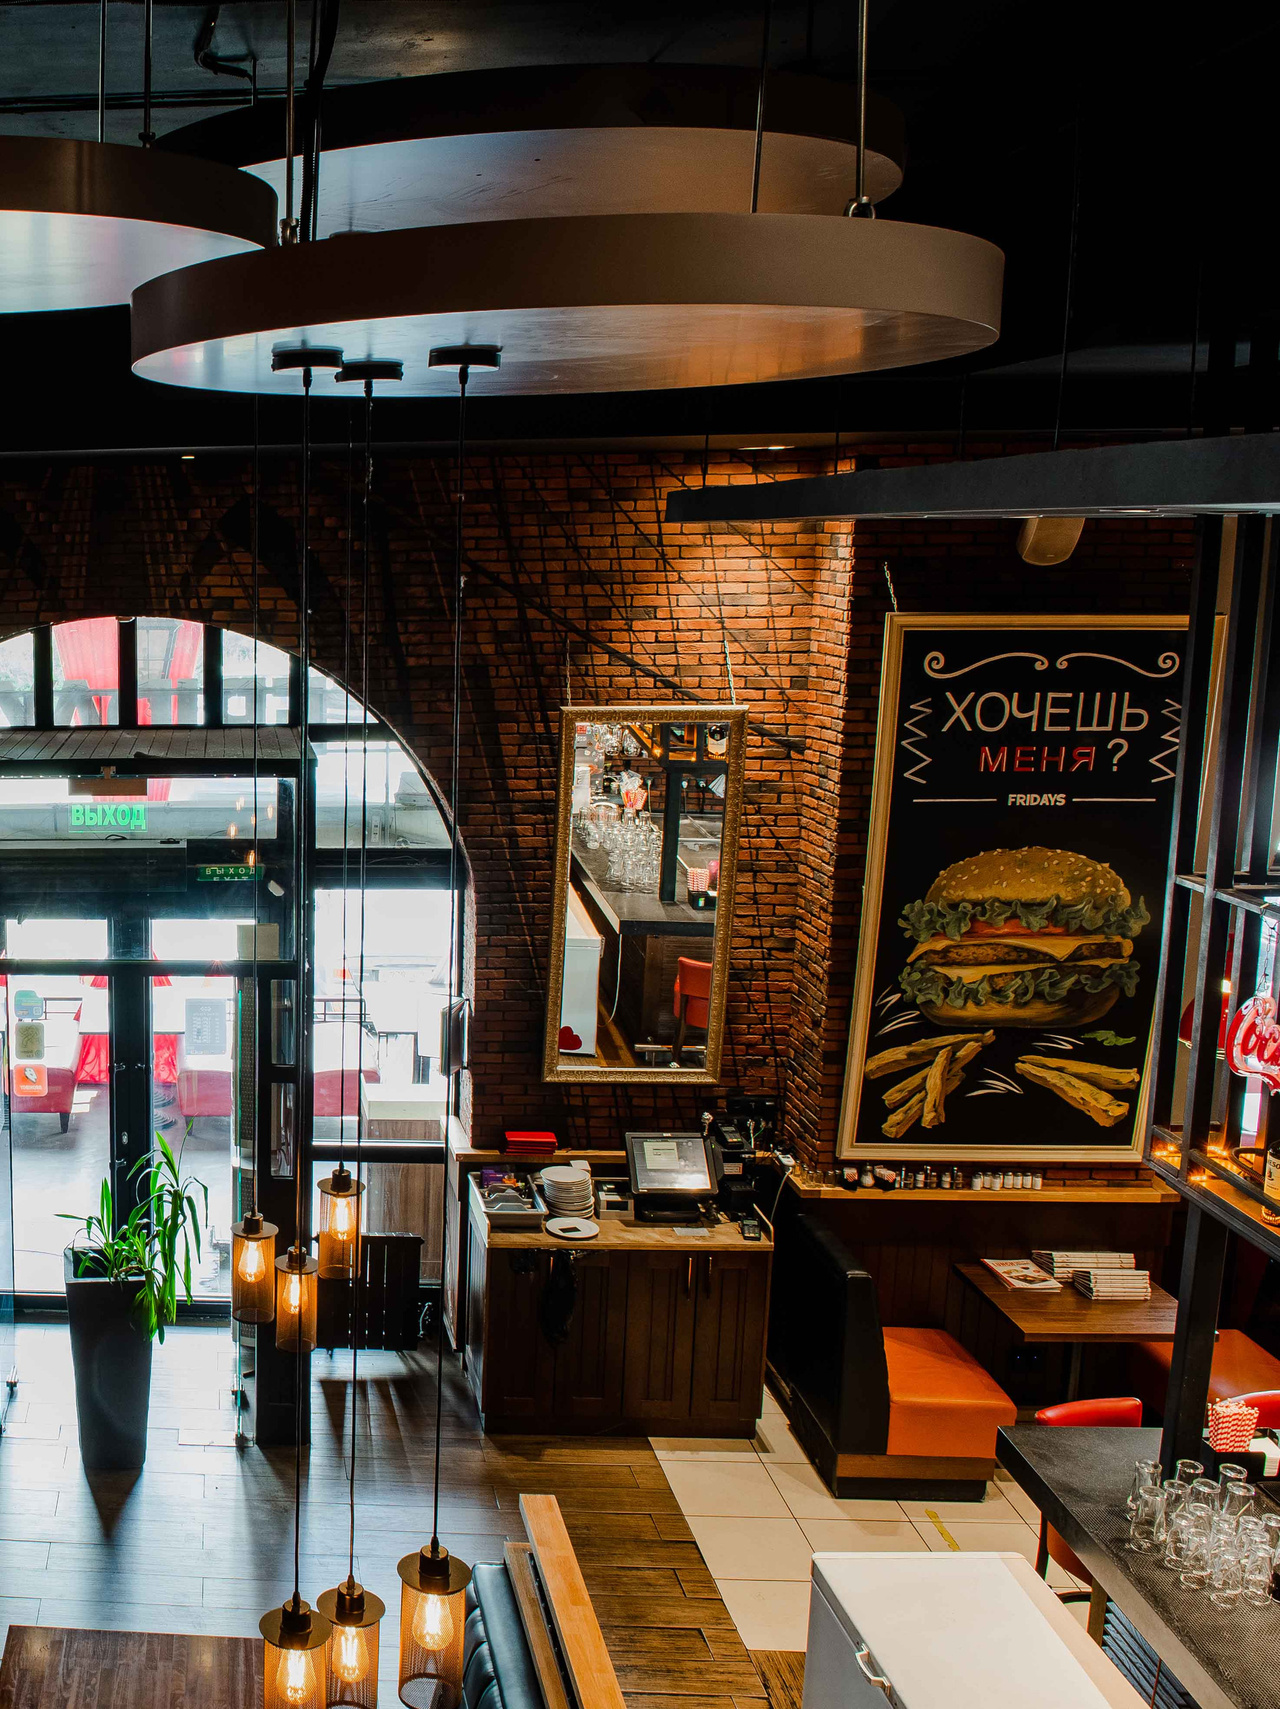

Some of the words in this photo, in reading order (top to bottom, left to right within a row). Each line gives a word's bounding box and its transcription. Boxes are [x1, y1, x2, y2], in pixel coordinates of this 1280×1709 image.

[941, 691, 1149, 732] ХОЧЕШЬ
[1007, 793, 1067, 807] FRIDAYS
[70, 803, 146, 830] ВЫХОД
